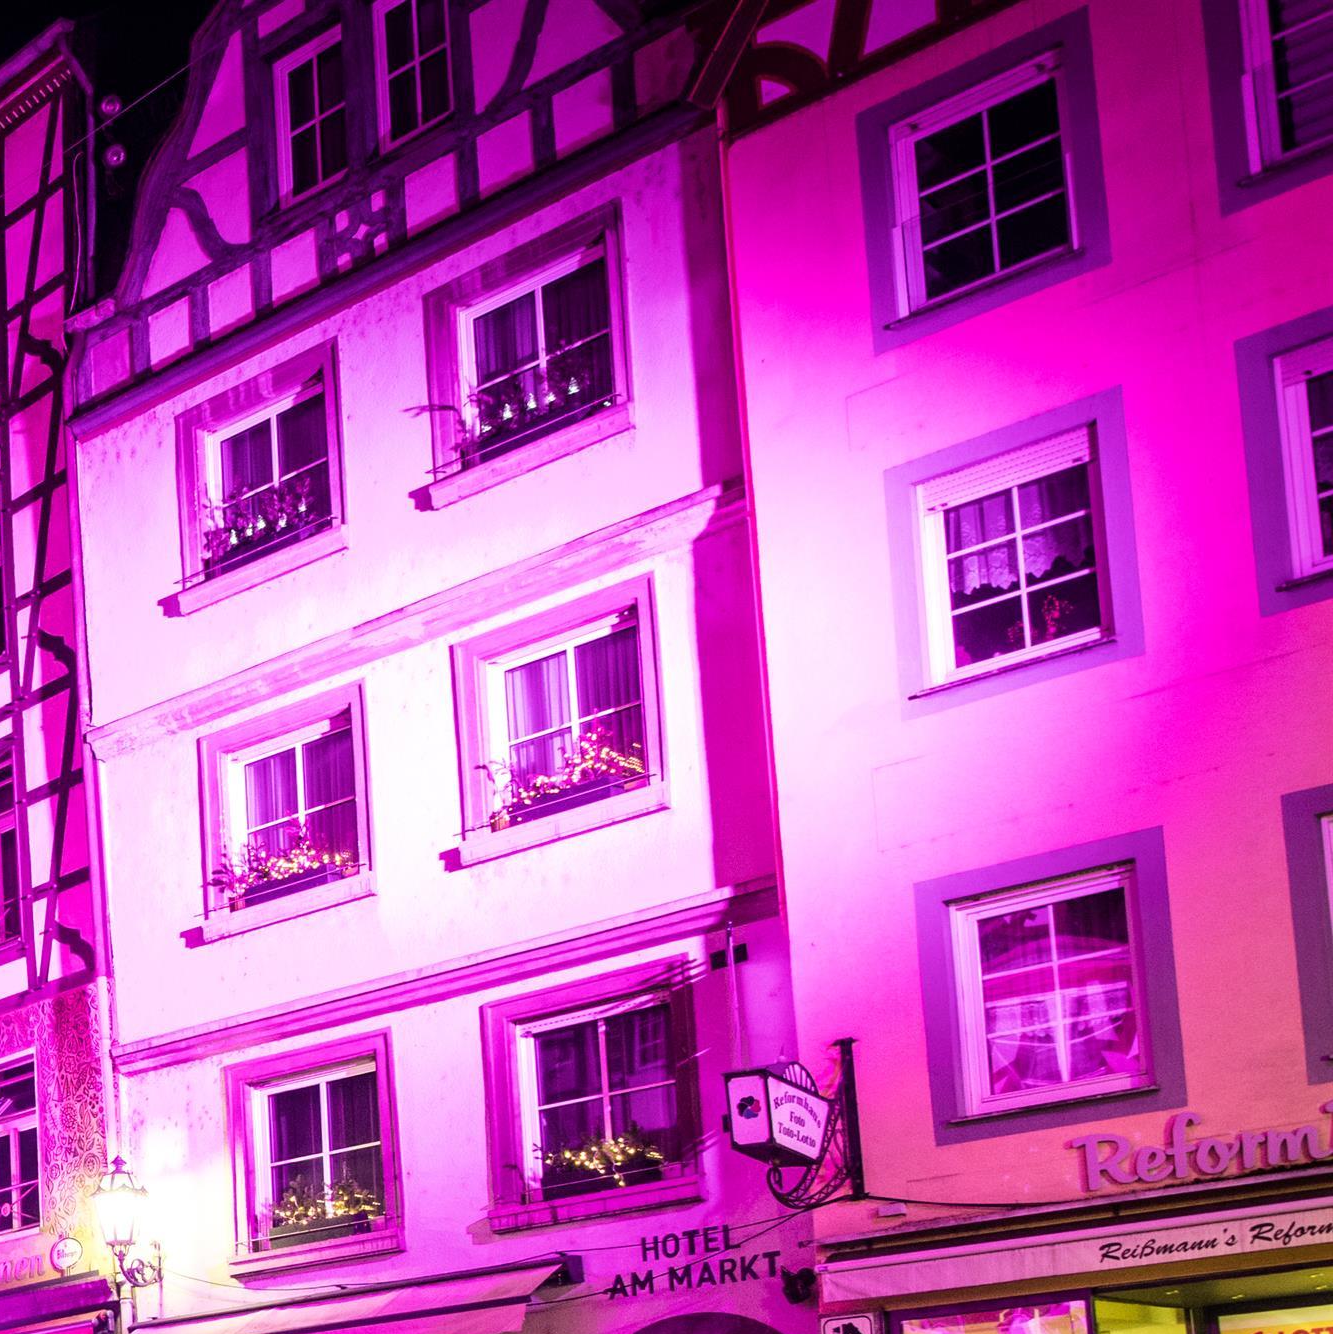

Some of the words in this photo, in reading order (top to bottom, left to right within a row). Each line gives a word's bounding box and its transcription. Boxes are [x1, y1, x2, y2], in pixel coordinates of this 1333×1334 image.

[774, 1091, 821, 1128] Reformhaus
[790, 1111, 806, 1127] Foto
[778, 1122, 816, 1148] Toto-Lotto
[1071, 1100, 1333, 1191] Reform
[641, 1225, 741, 1262] HOTEL
[1099, 1228, 1238, 1263] Reißmann's
[609, 1270, 655, 1299] AM
[668, 1251, 780, 1291] MARKT
